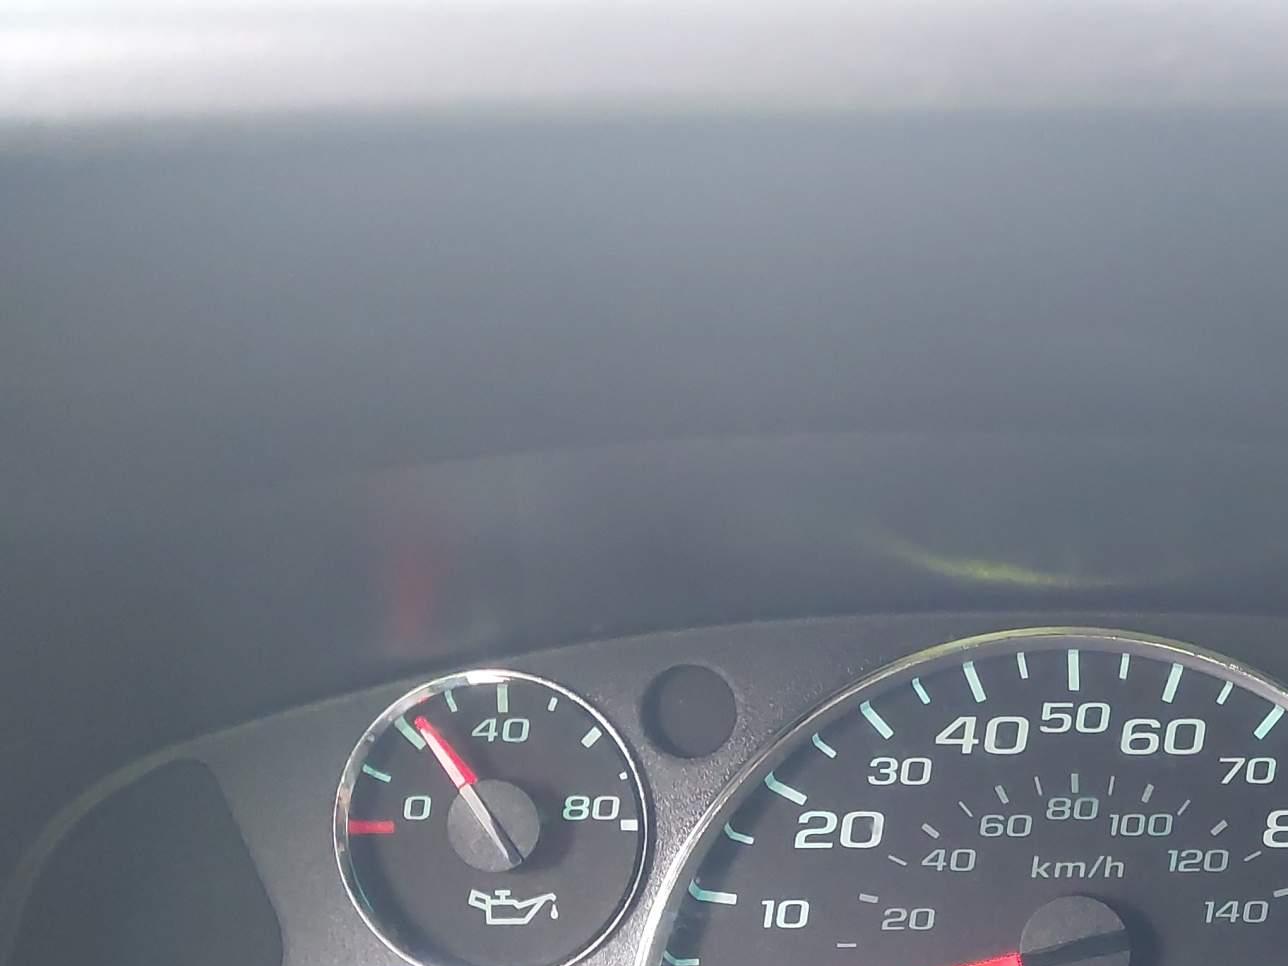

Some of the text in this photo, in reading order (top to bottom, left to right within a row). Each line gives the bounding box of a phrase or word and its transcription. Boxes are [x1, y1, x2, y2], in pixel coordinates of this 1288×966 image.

[1040, 702, 1110, 733] 50
[472, 718, 529, 742] 40
[935, 715, 1030, 755] 40
[1120, 718, 1206, 755] 60
[867, 757, 932, 786] 30
[1218, 757, 1276, 784] 70
[403, 795, 431, 820] 0
[562, 795, 620, 821] 80
[1046, 797, 1098, 820] 80
[794, 810, 884, 849] 20
[979, 814, 1032, 837] 60
[1110, 814, 1173, 836] 100
[921, 848, 976, 871] 40
[1031, 856, 1124, 879] km/h
[1168, 849, 1229, 872] 120
[761, 899, 809, 929] 10
[881, 908, 935, 930] 20
[1204, 901, 1268, 924] 140
